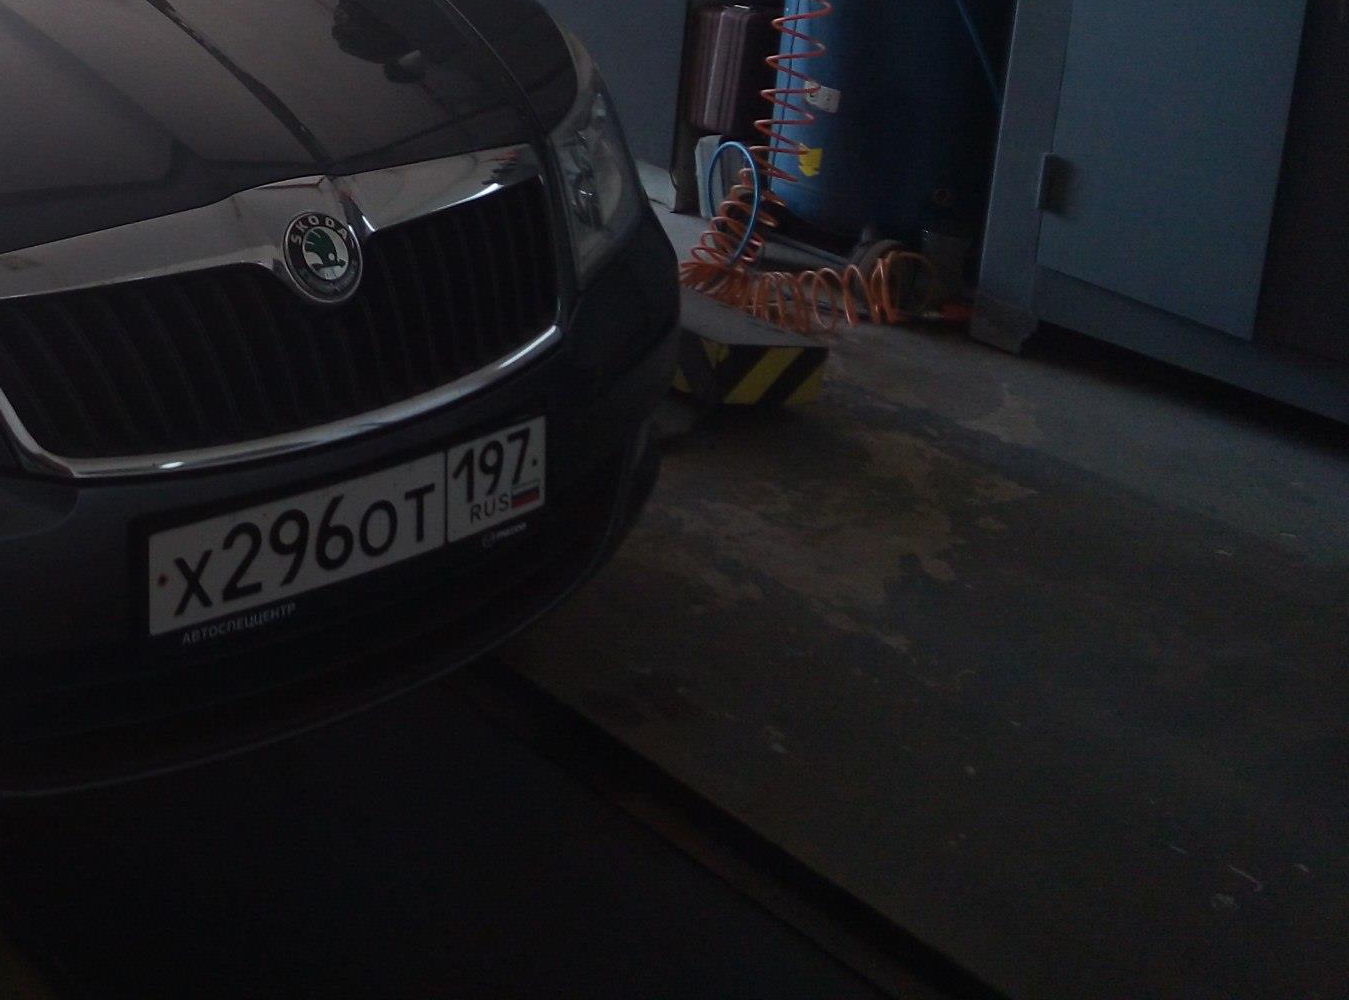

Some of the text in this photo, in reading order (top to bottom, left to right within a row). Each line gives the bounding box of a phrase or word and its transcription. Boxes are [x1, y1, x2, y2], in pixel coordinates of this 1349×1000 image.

[172, 427, 532, 617] Х296ОТ 197
[470, 493, 510, 525] RUS
[181, 601, 298, 646] АВТОСПЕЦЦЕНТР
